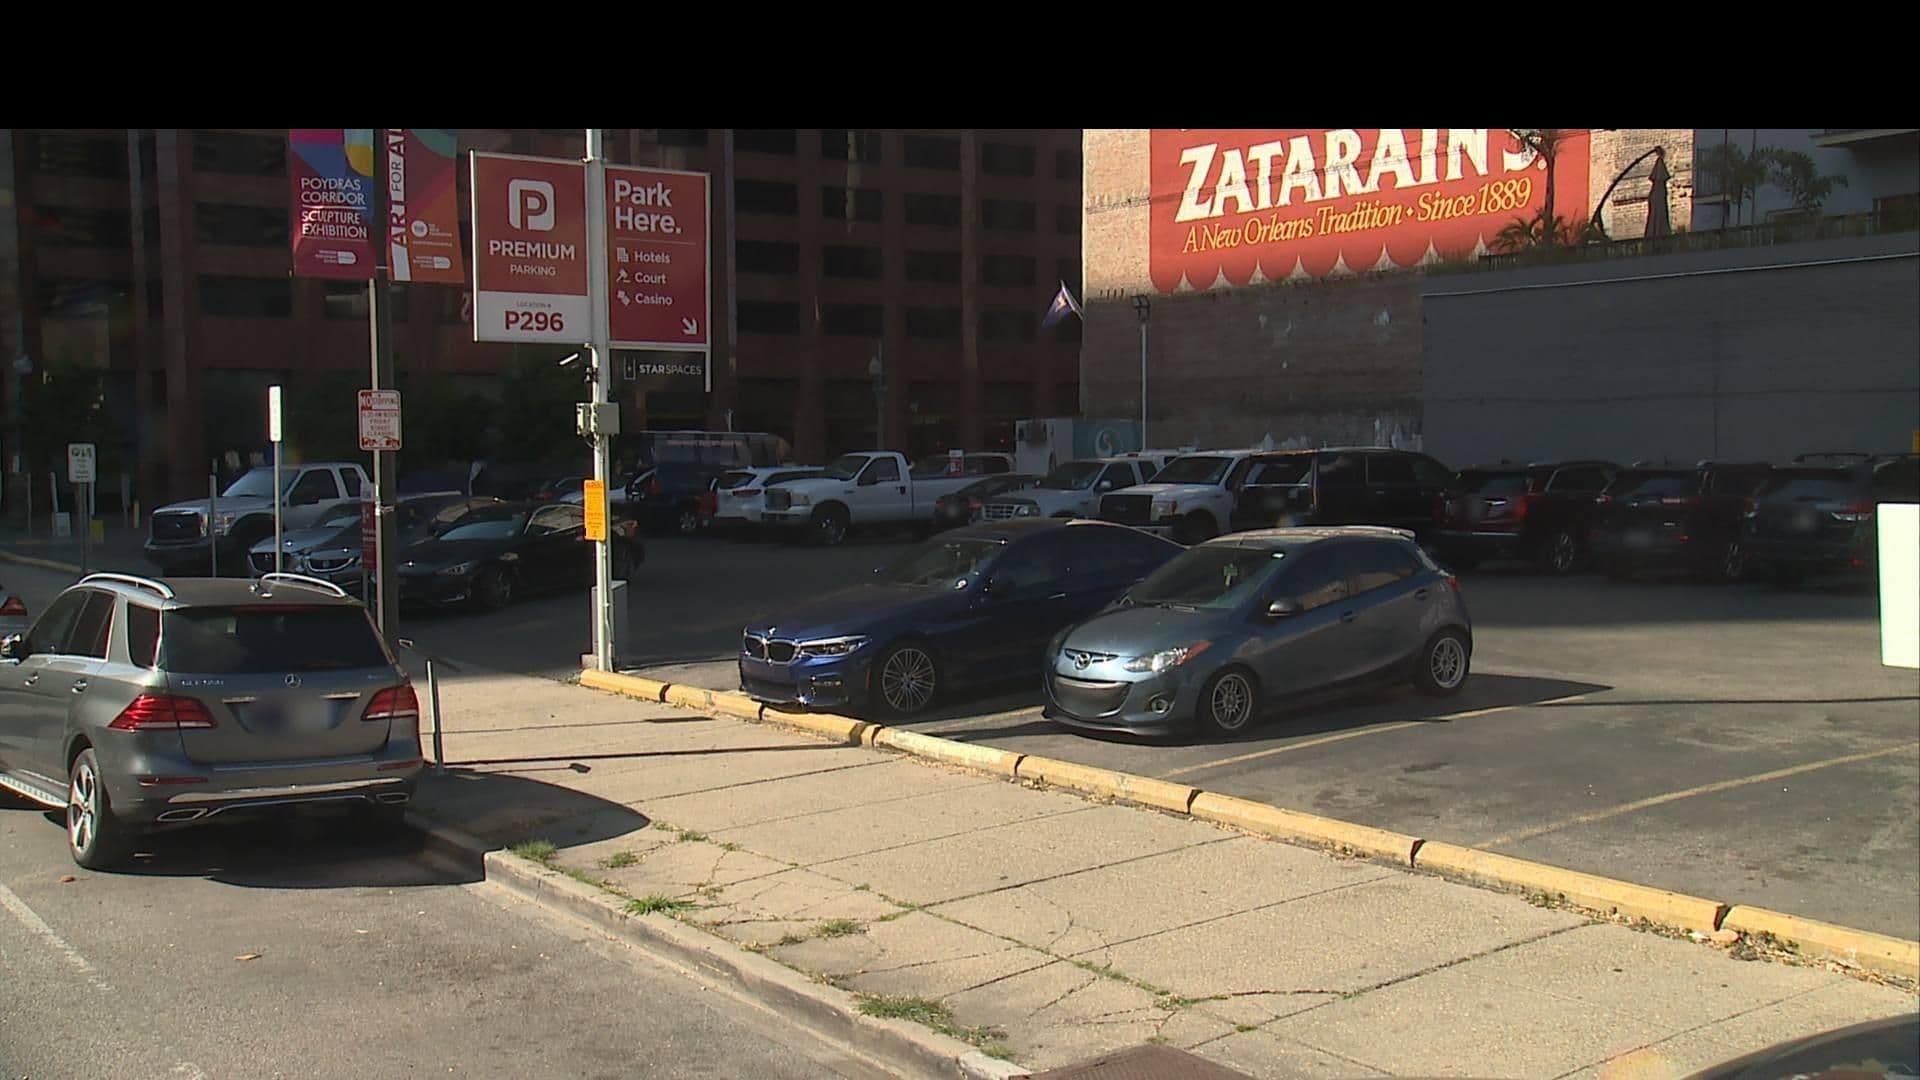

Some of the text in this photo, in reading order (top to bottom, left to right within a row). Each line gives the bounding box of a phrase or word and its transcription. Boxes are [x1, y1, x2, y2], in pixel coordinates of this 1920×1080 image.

[391, 160, 402, 192] FOR
[614, 179, 672, 208] Park
[302, 210, 361, 225] SCULPTURE
[390, 199, 407, 248] ART
[614, 205, 682, 235] Here.
[1182, 176, 1533, 253] A New Orleans Tradition Since 1889
[302, 222, 368, 239] EXHIBITION
[489, 239, 576, 261] PREMIUM
[634, 250, 671, 264] Hotels
[509, 263, 557, 277] PARKING
[634, 271, 667, 285] Court
[634, 292, 673, 306] Casino
[504, 310, 565, 332] P296
[639, 363, 702, 376] STARSPACES
